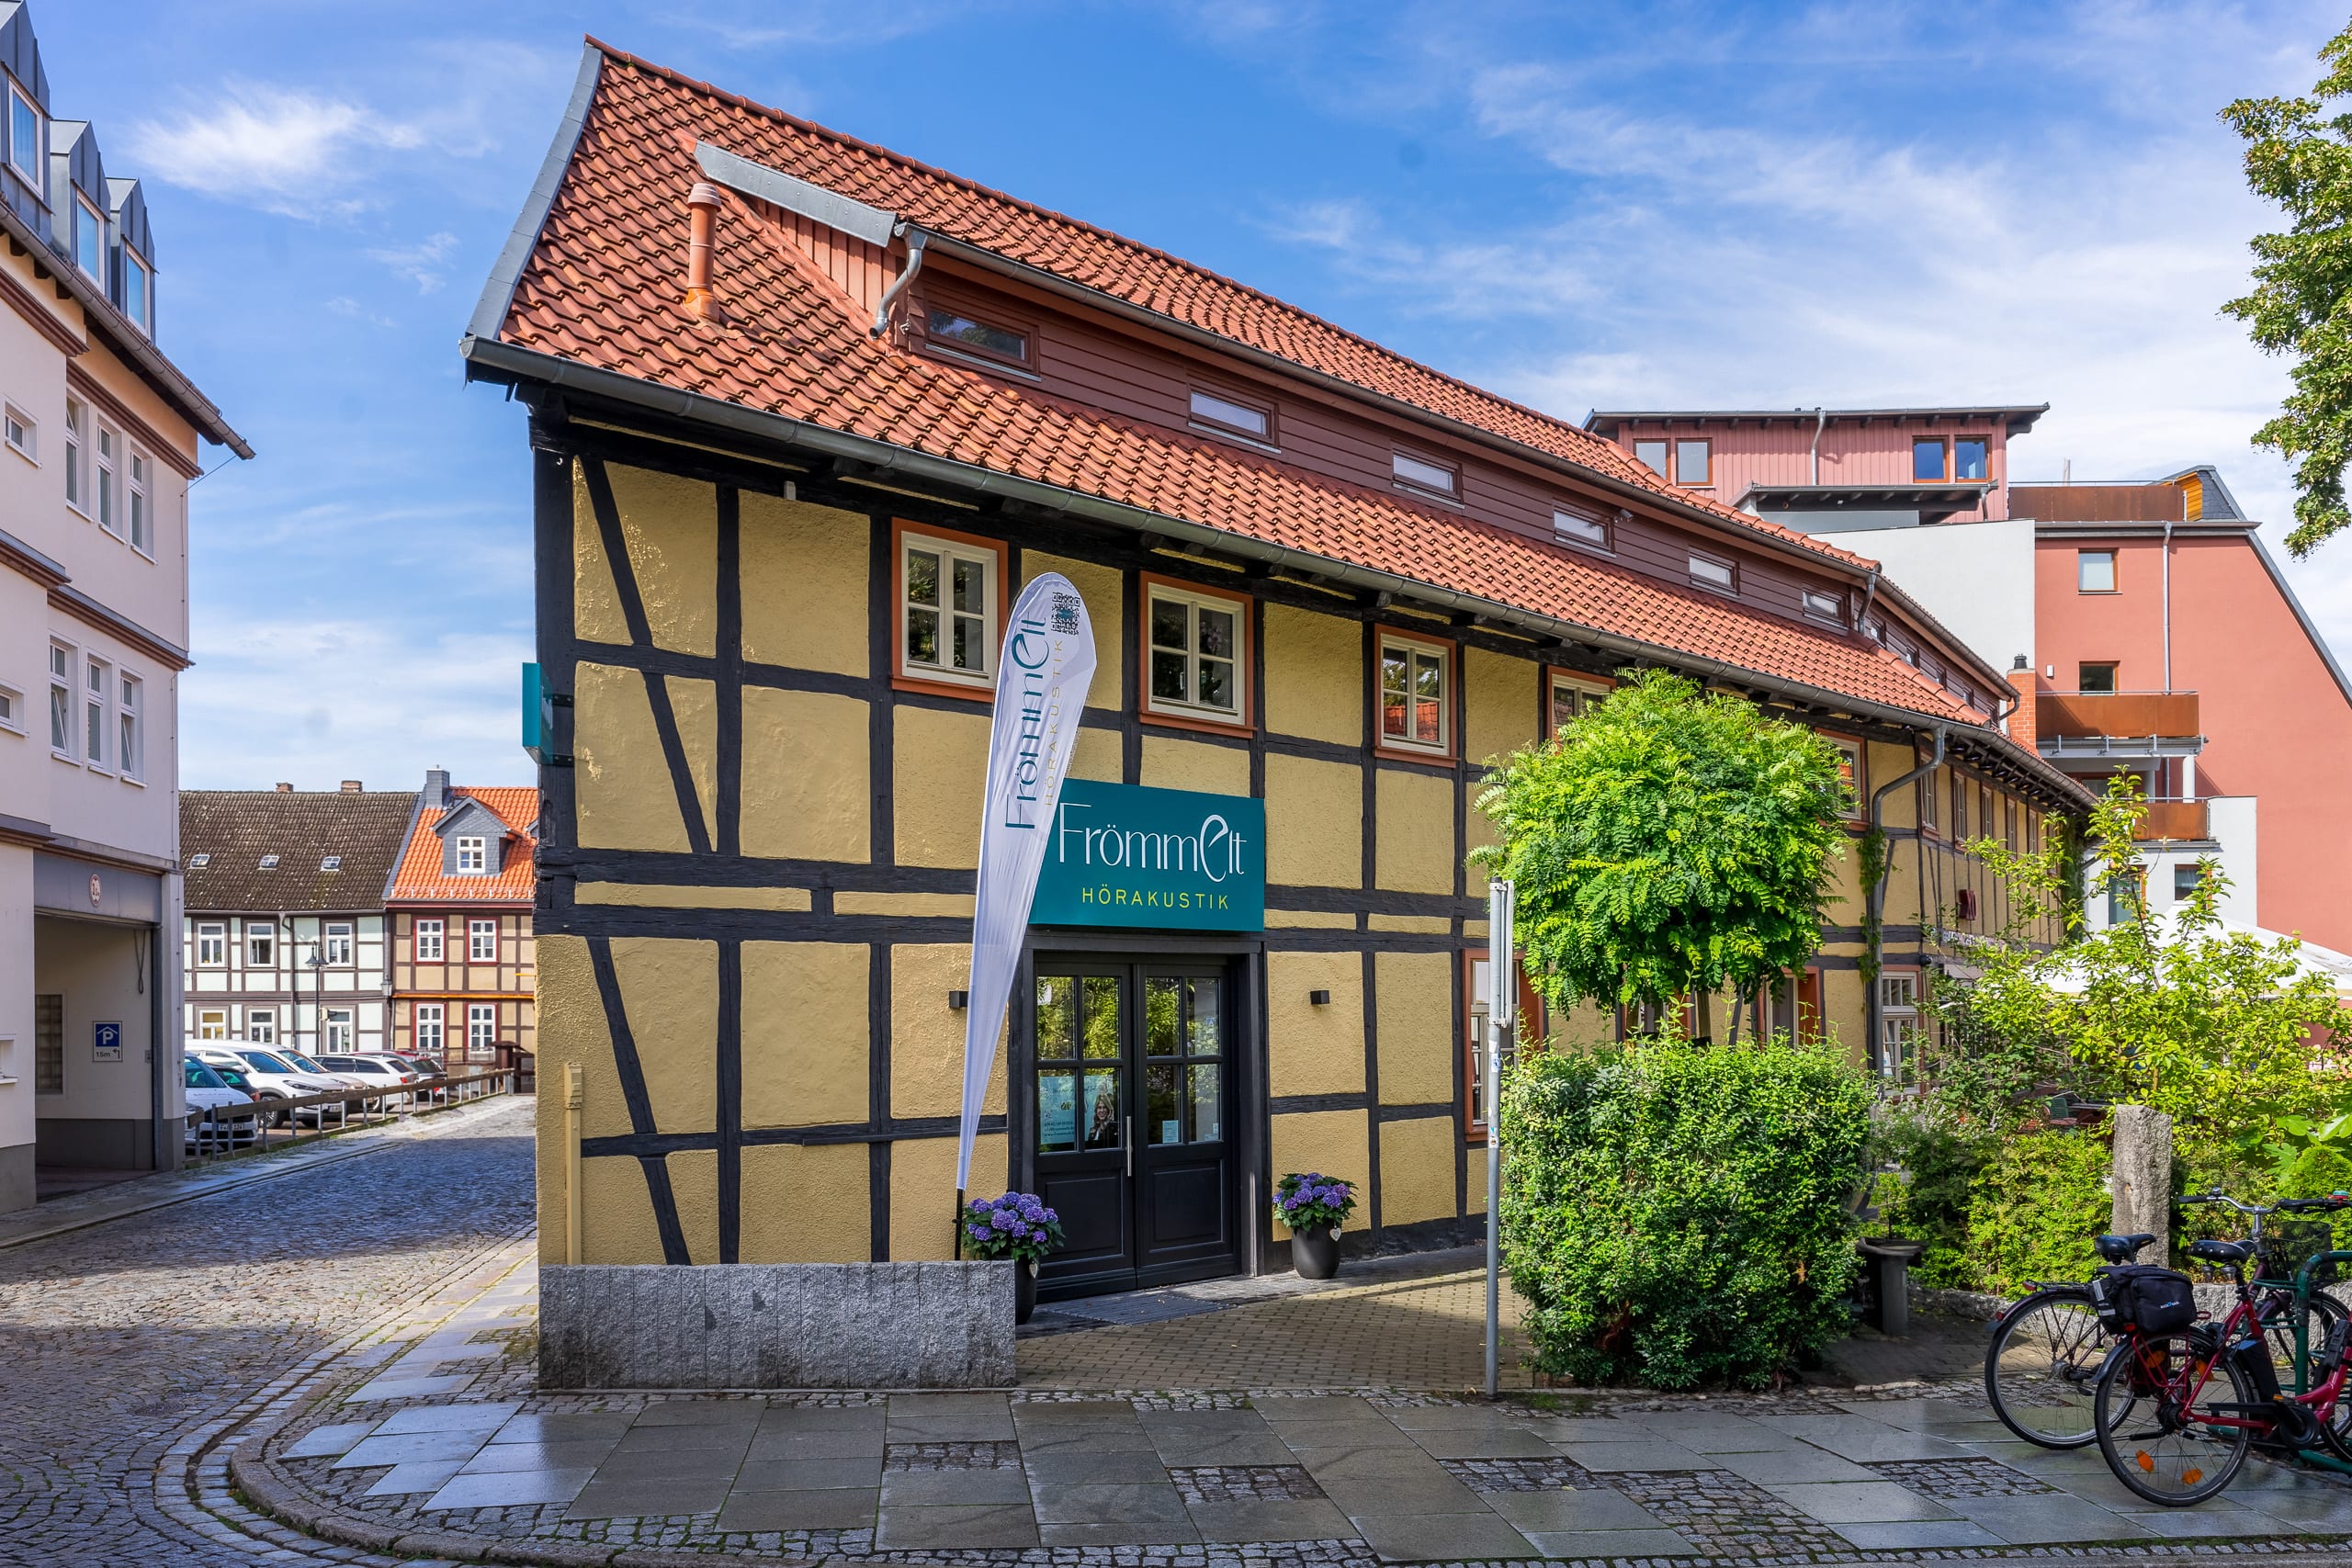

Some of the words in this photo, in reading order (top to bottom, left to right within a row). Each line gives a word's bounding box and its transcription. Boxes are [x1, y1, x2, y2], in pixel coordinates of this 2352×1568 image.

[1005, 612, 1049, 829] Frömmelt
[1046, 639, 1064, 806] HÖRAKUSTIK
[1059, 802, 1248, 883] Frömmelt
[1082, 884, 1228, 910] HÖRAKUSTIK
[102, 1031, 114, 1044] P
